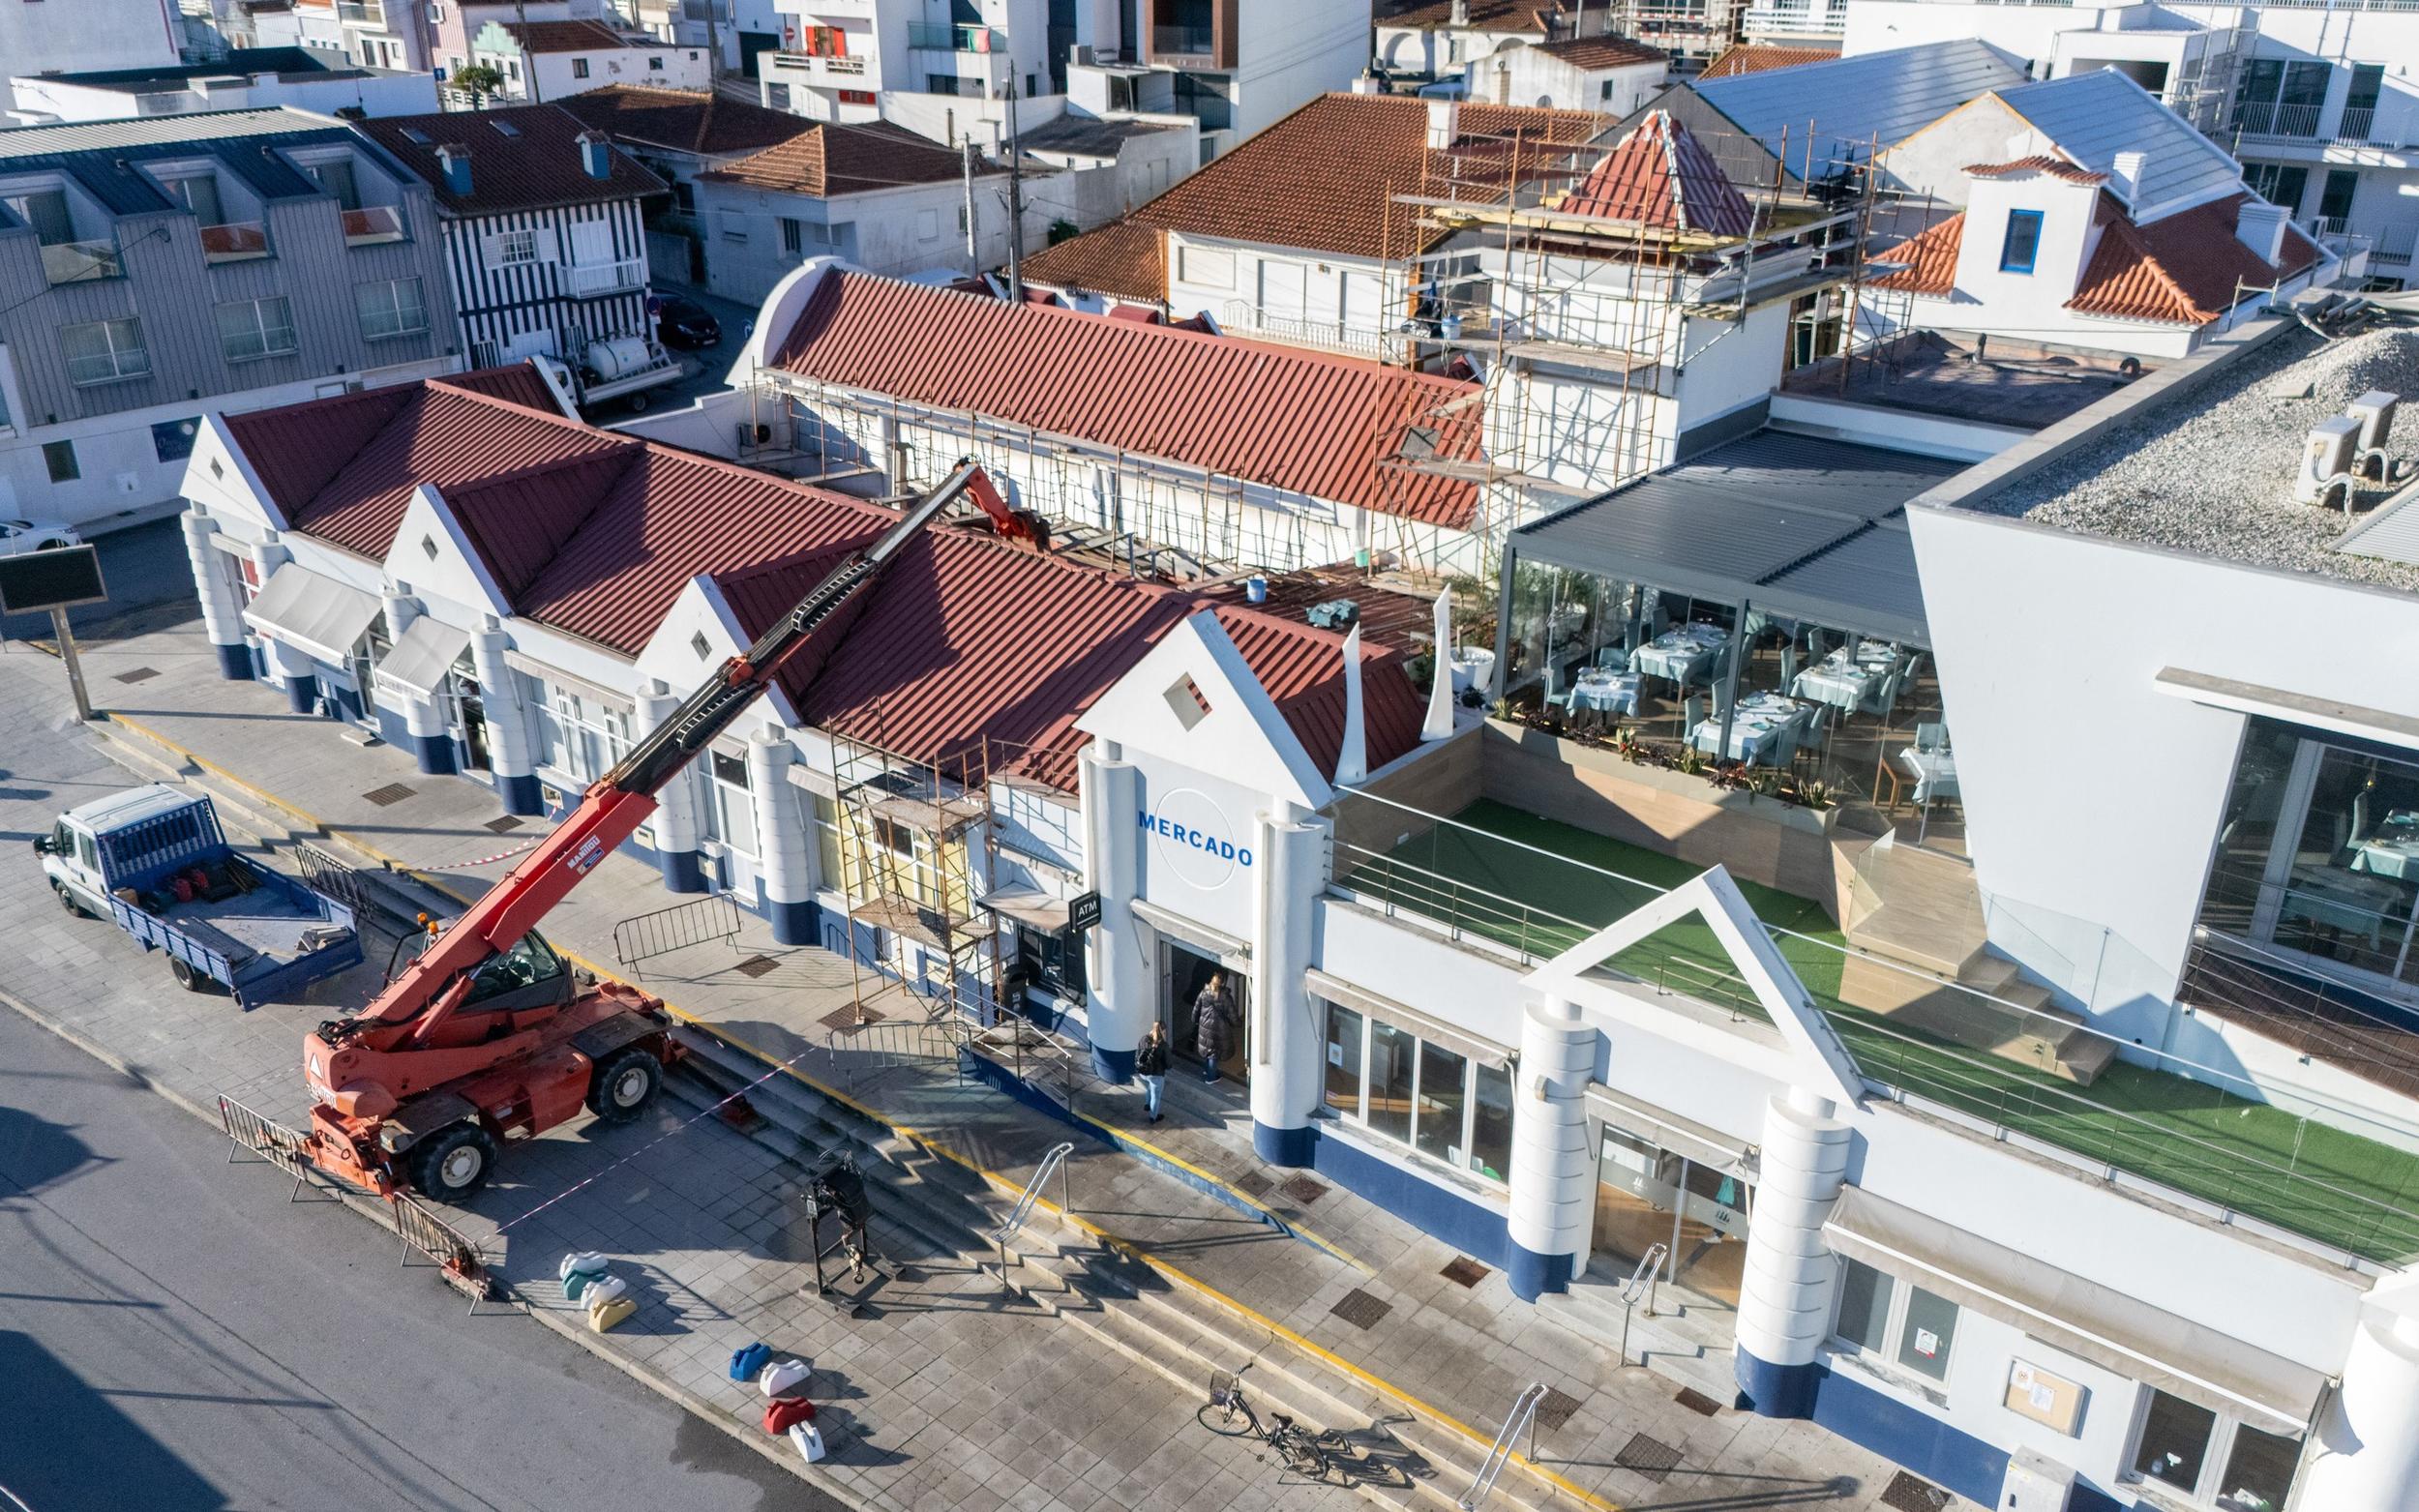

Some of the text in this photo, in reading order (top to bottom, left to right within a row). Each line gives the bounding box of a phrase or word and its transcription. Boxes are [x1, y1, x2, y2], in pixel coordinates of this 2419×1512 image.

[567, 835, 601, 869] MANITOU
[1139, 811, 1252, 867] MERCADO
[1078, 901, 1097, 918] ATM
